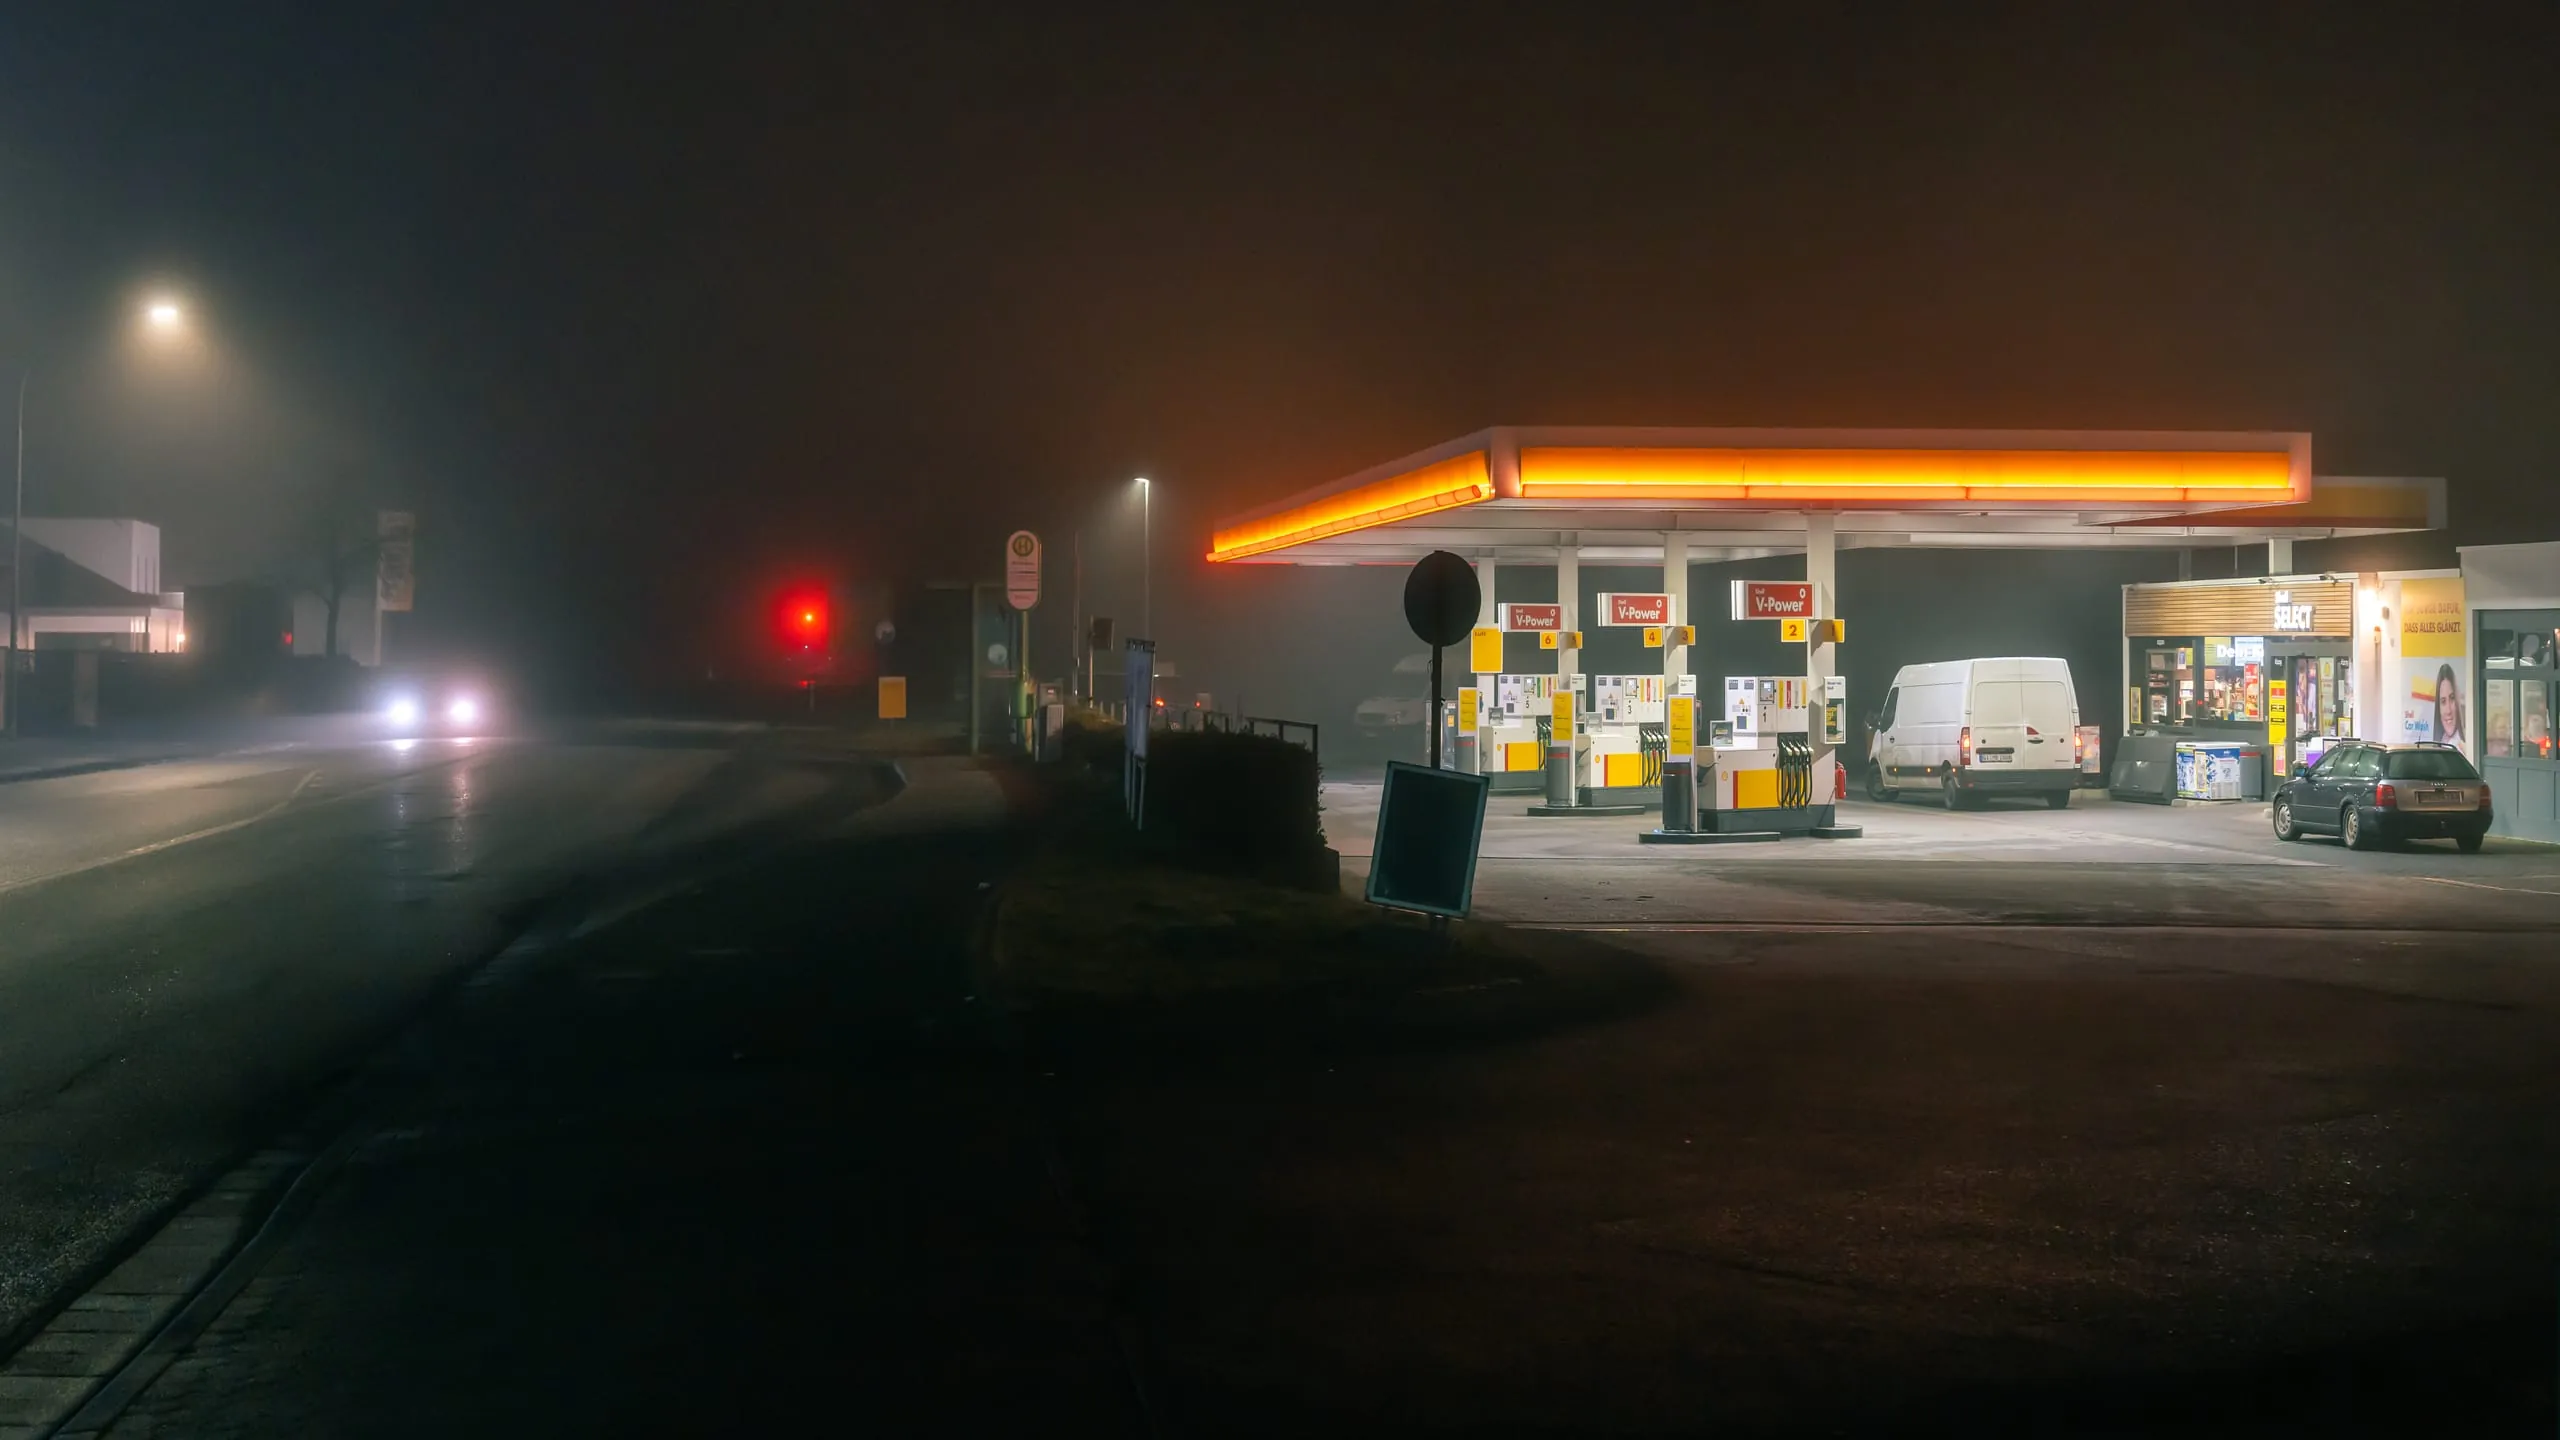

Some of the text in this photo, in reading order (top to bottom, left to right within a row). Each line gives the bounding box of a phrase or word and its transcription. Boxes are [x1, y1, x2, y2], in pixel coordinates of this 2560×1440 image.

[1756, 597, 1804, 612] V-Power
[1618, 606, 1660, 619] V-Power
[2274, 605, 2312, 629] SELECT
[1516, 614, 1554, 626] V-Power
[1789, 624, 1797, 636] 2
[2404, 622, 2418, 633] DASS
[2419, 621, 2436, 632] ALLES
[1545, 635, 1552, 645] 6
[1648, 632, 1656, 642] 4
[1682, 630, 1689, 641] 3
